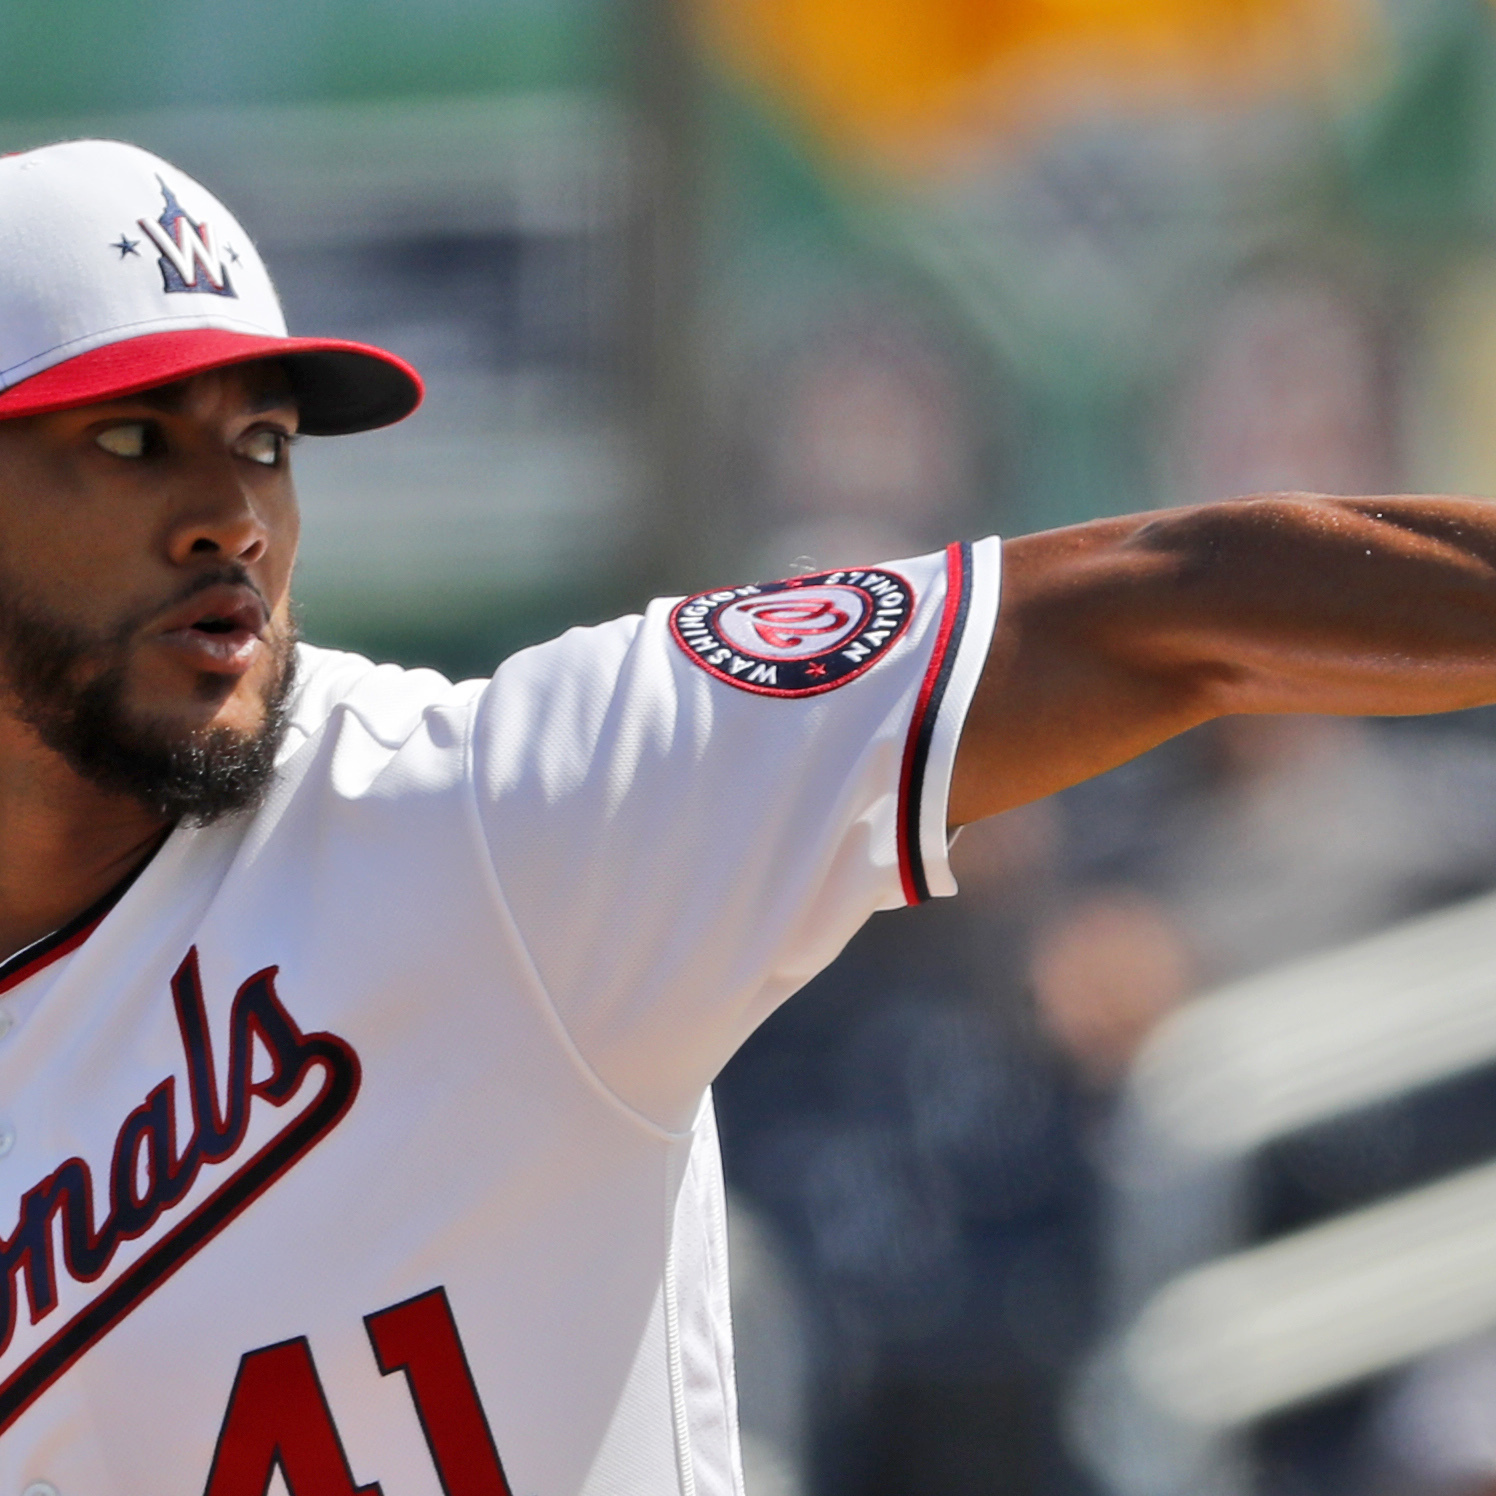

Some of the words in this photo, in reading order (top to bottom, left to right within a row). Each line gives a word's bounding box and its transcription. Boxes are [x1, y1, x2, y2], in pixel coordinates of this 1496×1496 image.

[136, 214, 225, 291] W
[678, 585, 778, 685] WASHINGTON
[824, 570, 905, 664] NATIONALS
